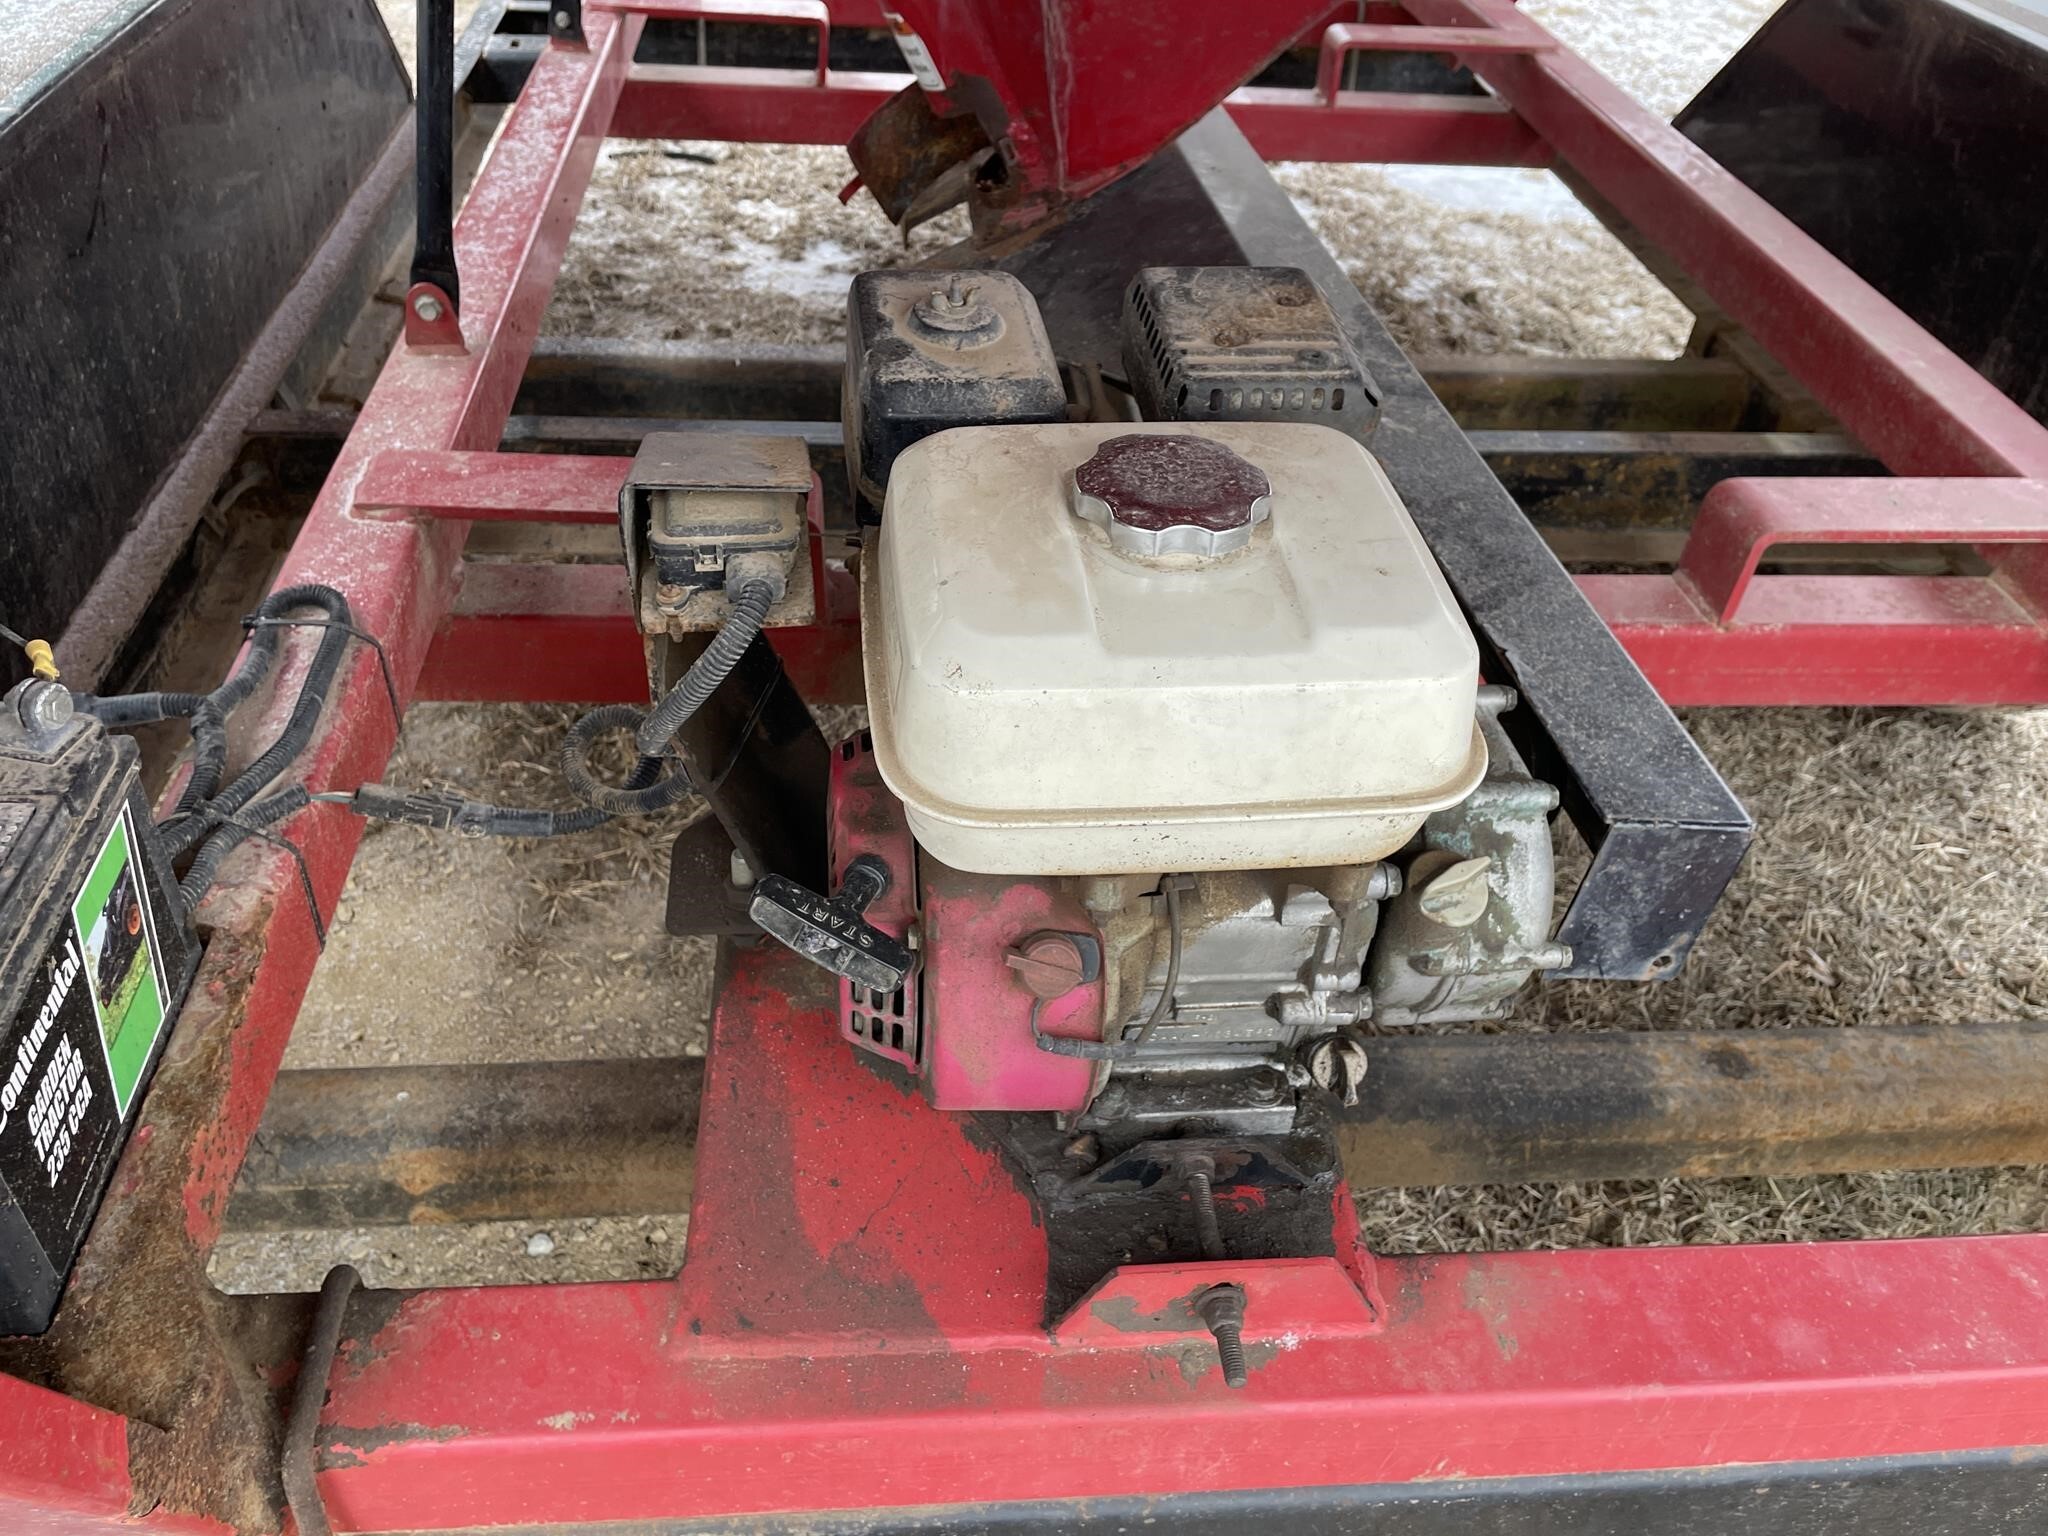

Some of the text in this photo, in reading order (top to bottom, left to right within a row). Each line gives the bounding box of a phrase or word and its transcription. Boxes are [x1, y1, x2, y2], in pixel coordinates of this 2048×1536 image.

[797, 902, 873, 948] START
[28, 1032, 72, 1136] GARDEN
[34, 1047, 84, 1163] TRACTOR
[47, 1123, 71, 1189] 235
[68, 1075, 93, 1136] CCA
